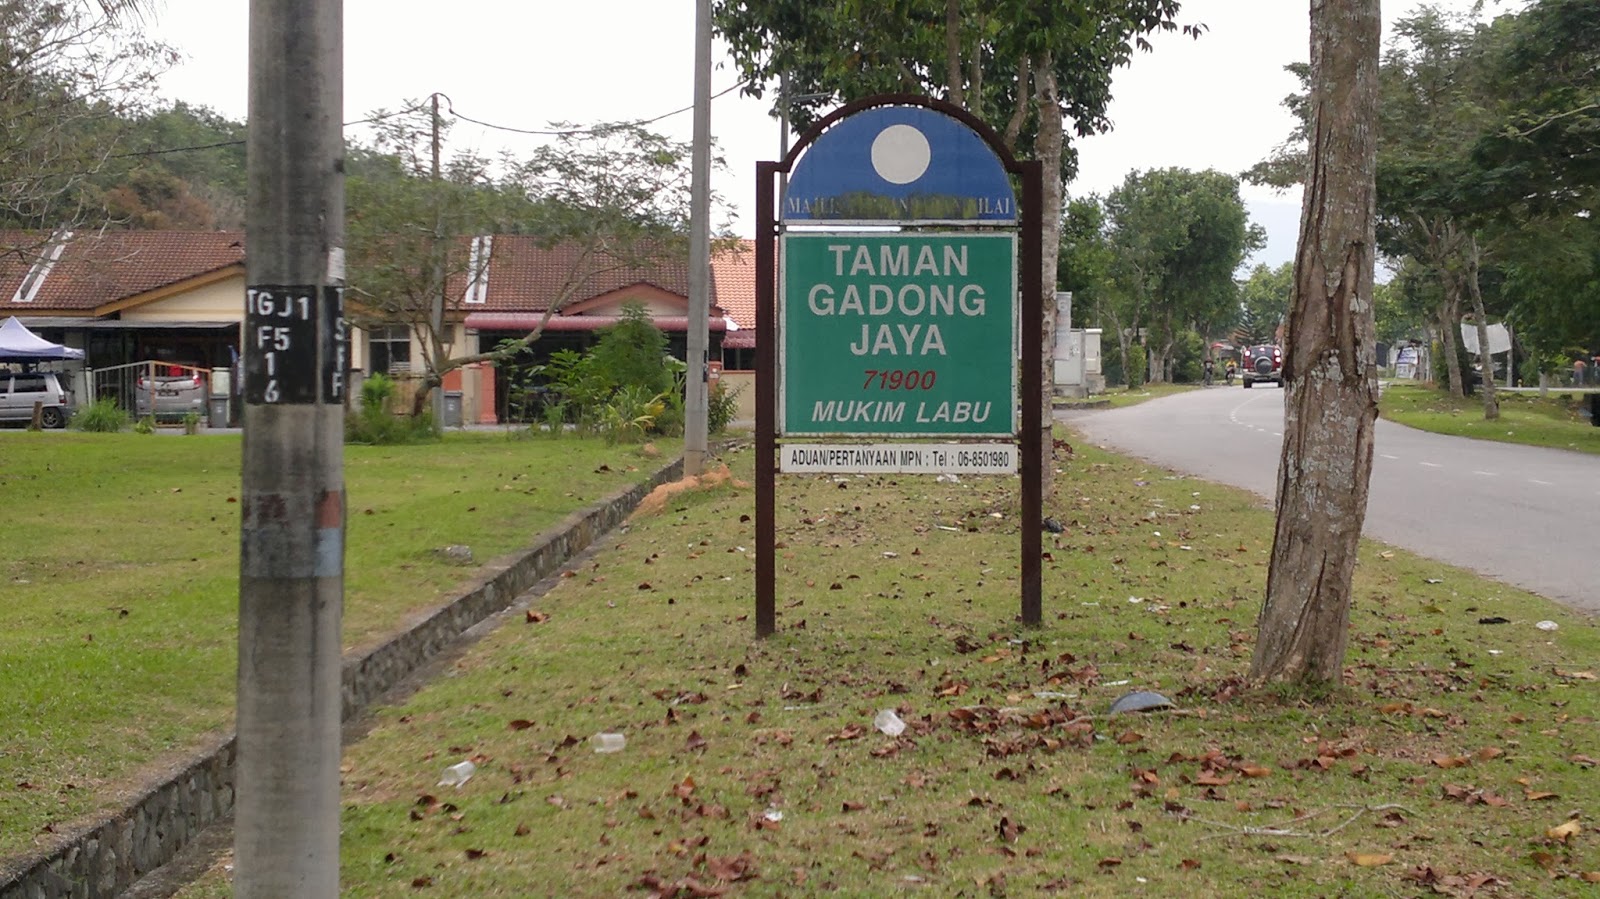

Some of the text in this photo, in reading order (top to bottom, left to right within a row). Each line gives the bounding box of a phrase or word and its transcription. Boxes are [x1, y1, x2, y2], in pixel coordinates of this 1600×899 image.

[828, 245, 968, 276] TAMAN
[808, 284, 986, 316] GADONG
[257, 326, 290, 351] F5
[850, 324, 947, 356] JAYA
[264, 379, 280, 403] 6
[863, 370, 937, 391] 71900
[811, 400, 992, 423] MUKIM LABU
[791, 449, 897, 466] ADUAN/PERTANYAAN
[900, 450, 922, 466] MPN
[932, 450, 947, 467] Tel
[957, 451, 1009, 467] 06-8501980
